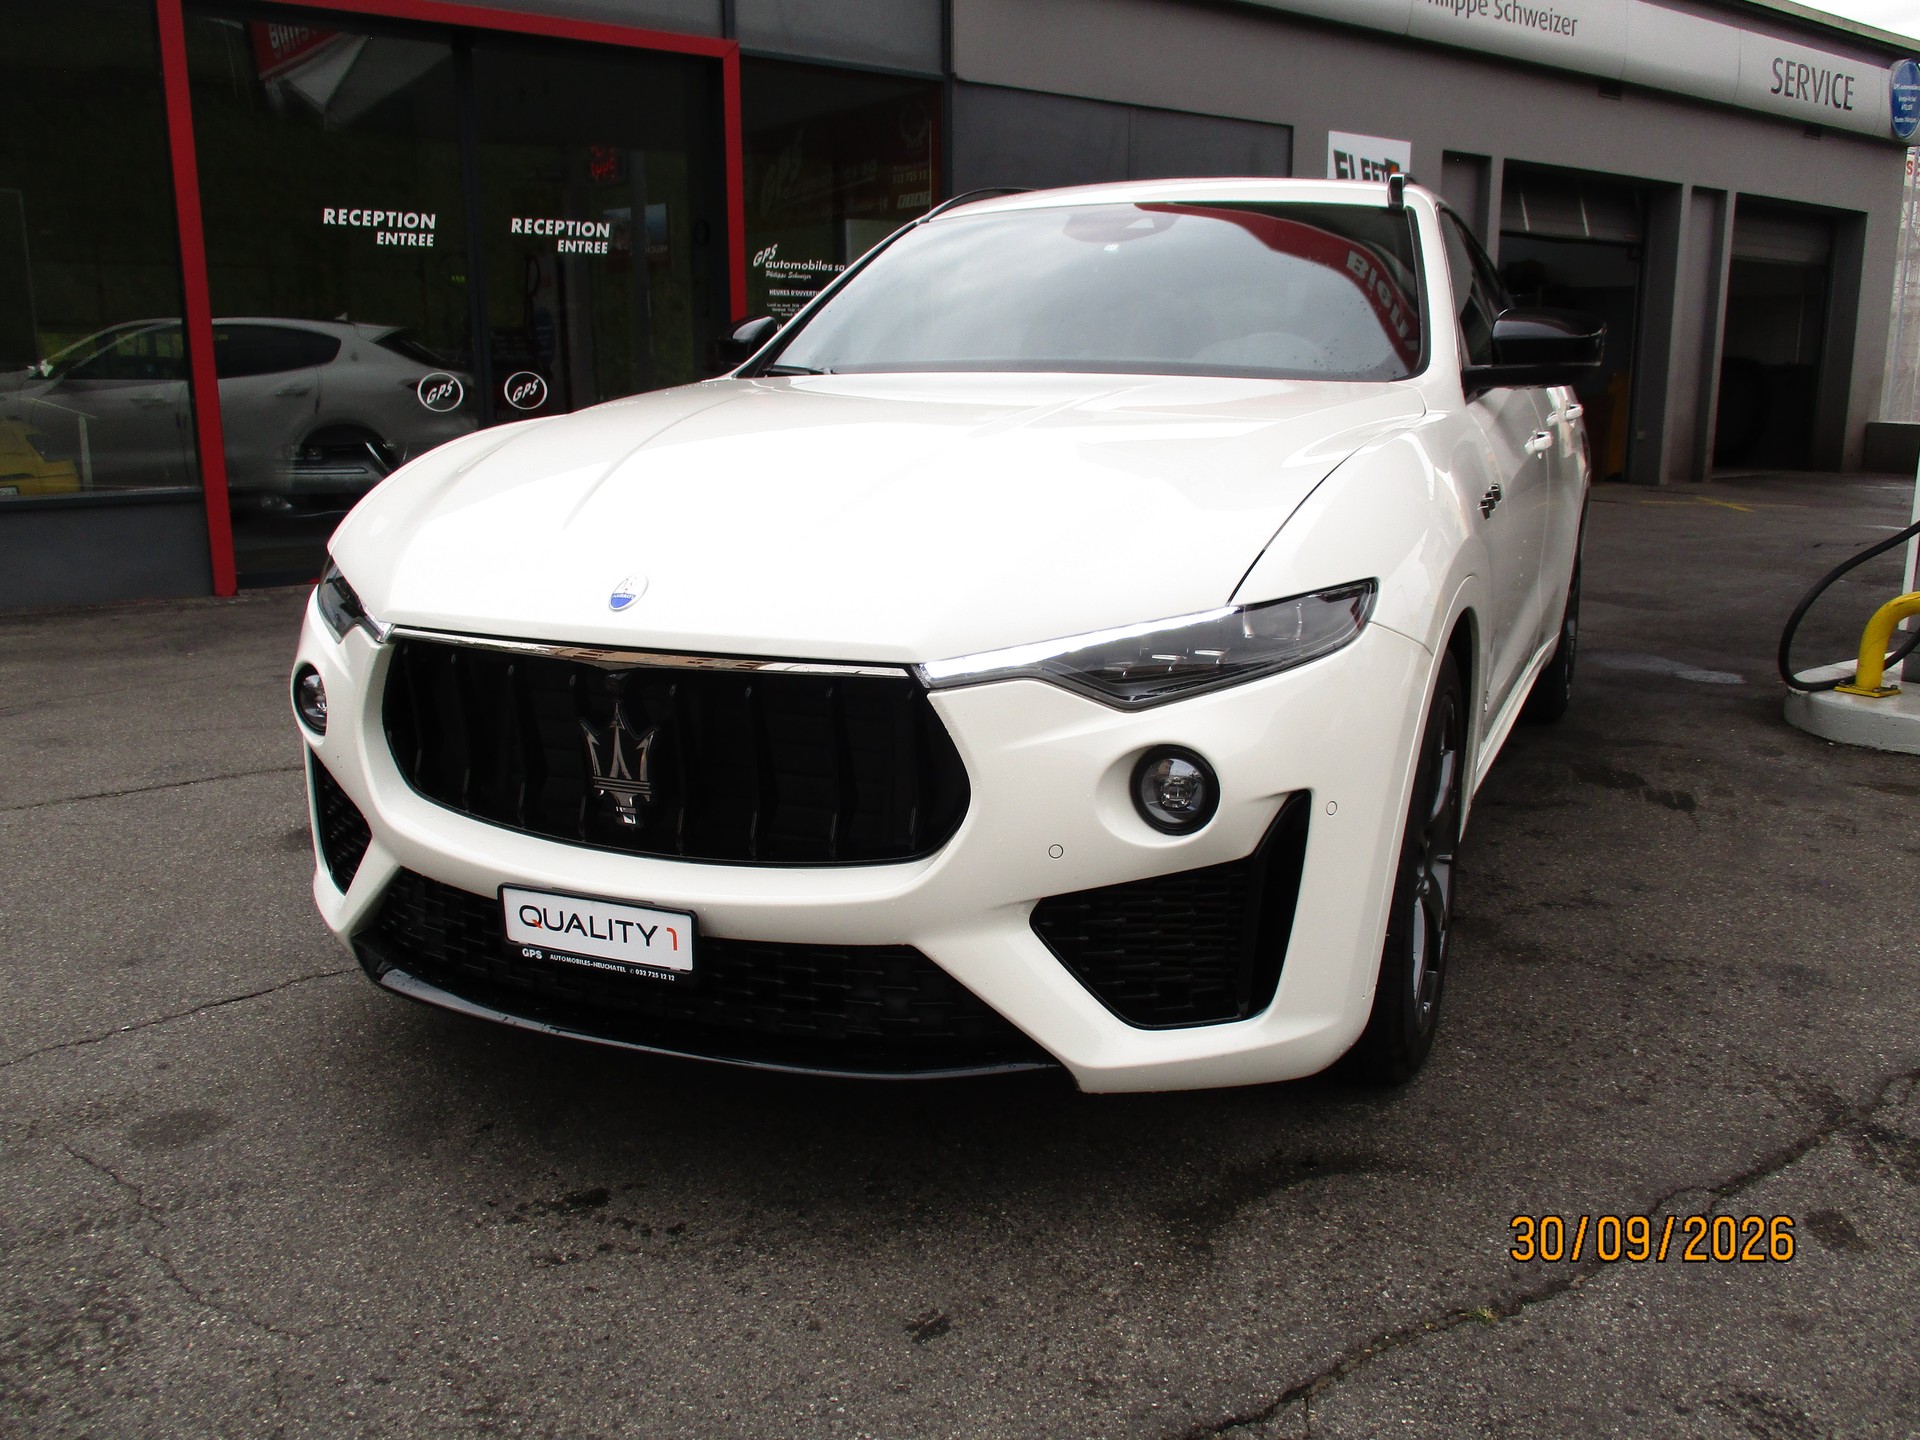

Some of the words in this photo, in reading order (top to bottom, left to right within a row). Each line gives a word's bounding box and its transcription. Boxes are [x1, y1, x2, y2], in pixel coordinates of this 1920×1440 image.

[1493, 0, 1578, 37] Schweizer
[1770, 57, 1855, 111] SERVICE
[323, 207, 436, 230] RECEPTION
[511, 217, 610, 238] RECEPTION
[376, 231, 434, 247] ENTREE
[557, 239, 609, 255] ENTREE
[753, 243, 778, 267] GPS
[765, 260, 833, 271] automobiles
[834, 264, 846, 272] sa
[427, 380, 454, 404] GPS
[513, 379, 539, 402] GPS
[519, 904, 659, 947] QUALITY
[666, 927, 678, 951] 1
[522, 948, 543, 960] GPS
[635, 968, 647, 977] 032
[648, 971, 659, 979] 725
[668, 974, 676, 982] 12
